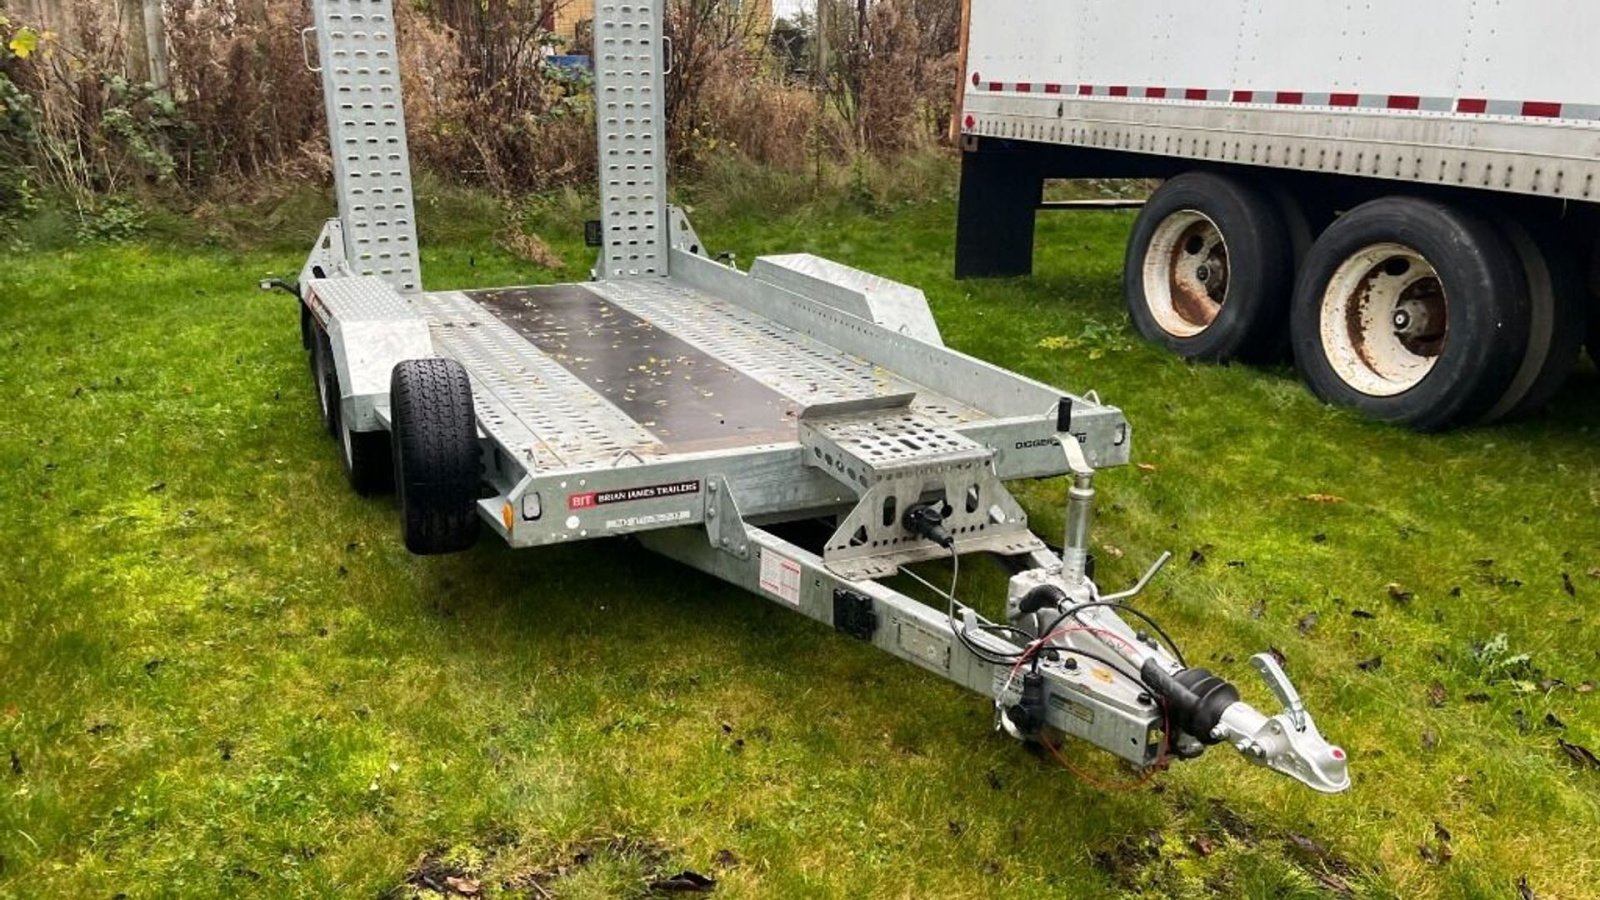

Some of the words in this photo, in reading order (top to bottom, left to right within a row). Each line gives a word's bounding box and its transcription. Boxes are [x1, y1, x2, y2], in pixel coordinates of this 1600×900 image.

[598, 492, 626, 503] BRIAN
[627, 489, 655, 500] JAMES
[656, 483, 697, 495] TRAILERS
